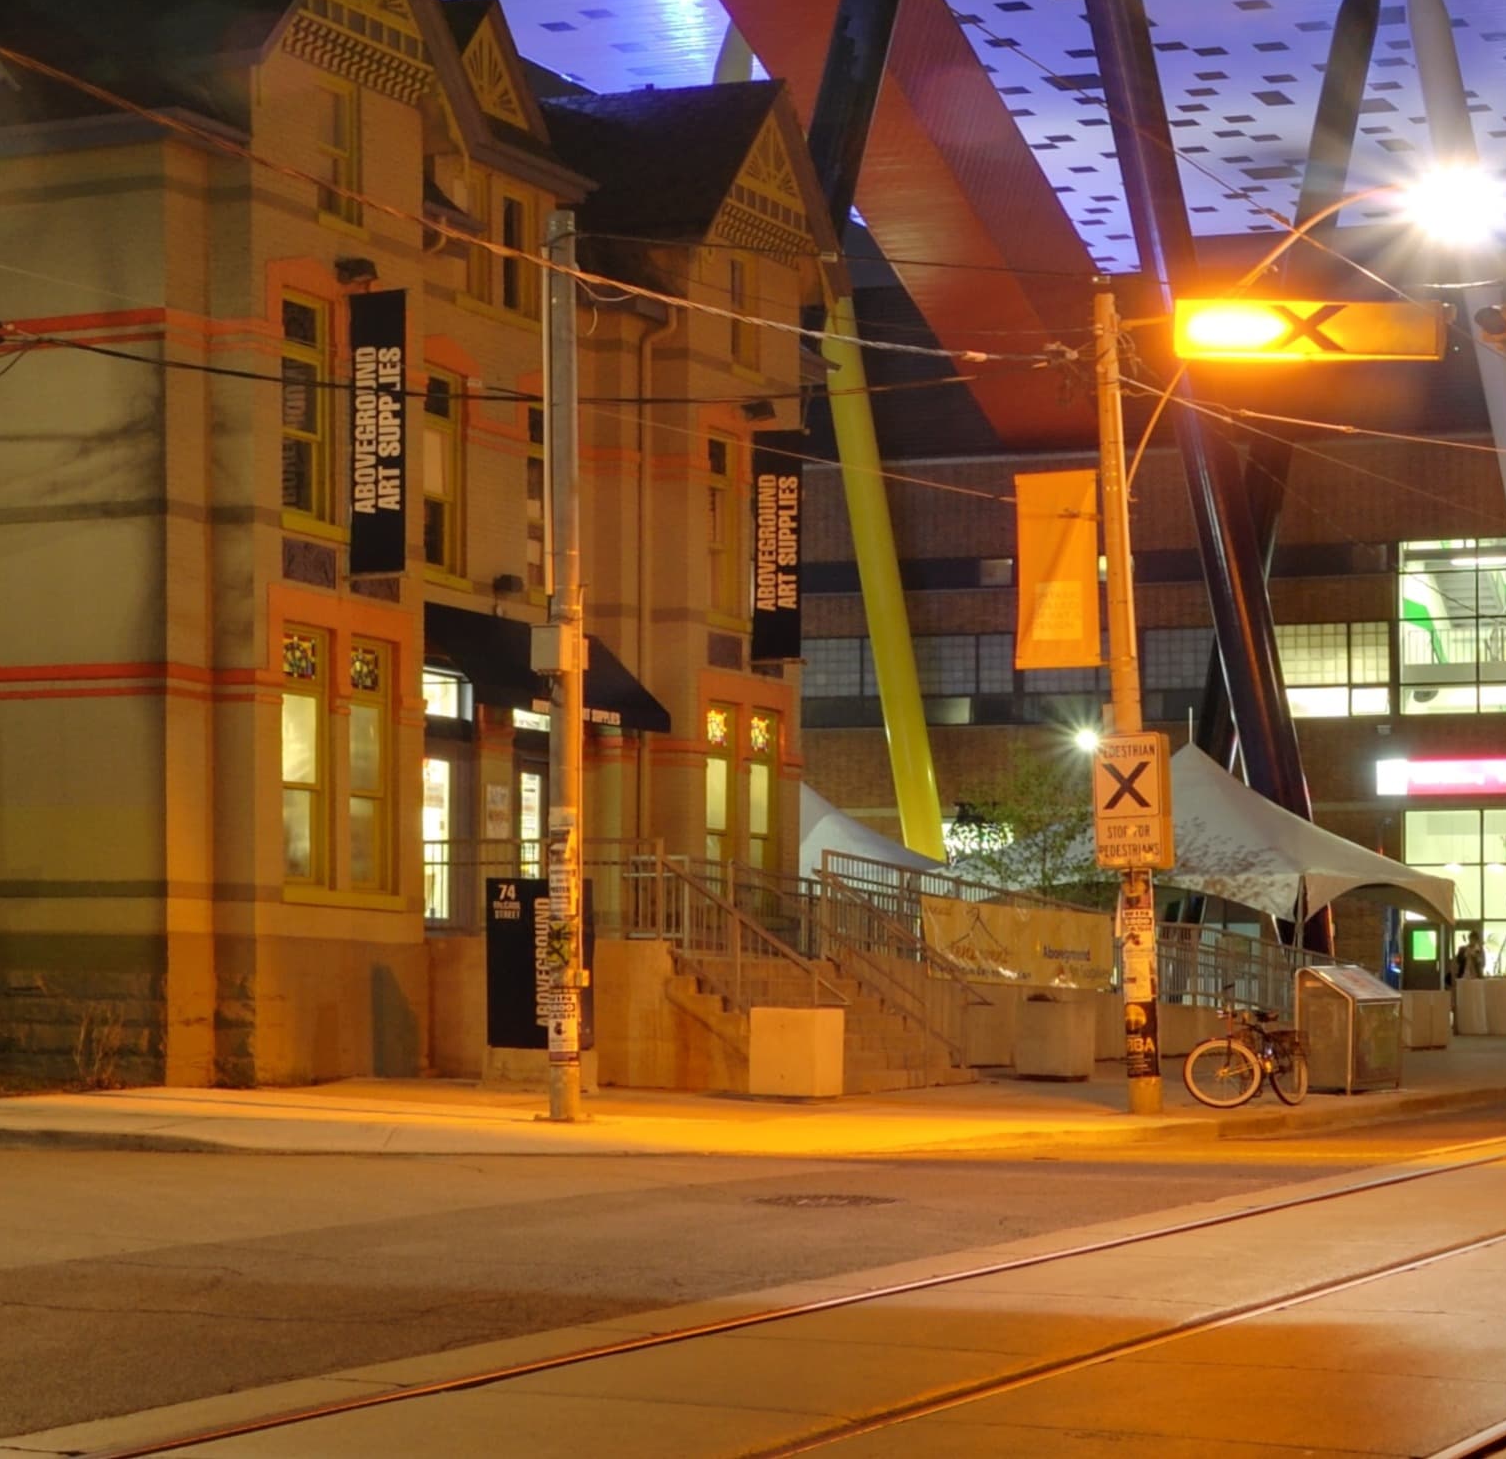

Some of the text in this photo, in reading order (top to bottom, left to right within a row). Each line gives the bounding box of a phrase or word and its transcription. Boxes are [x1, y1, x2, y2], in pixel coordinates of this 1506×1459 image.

[354, 346, 377, 515] ABOVEGROUND
[378, 346, 402, 511] ART SUPPLIES
[757, 474, 777, 612] ABOVEGROUND
[777, 475, 798, 610] ART SUPPLIES
[1100, 743, 1156, 759] PEDESTRIAN
[498, 884, 516, 902] 74
[1099, 843, 1161, 859] PEDESTRIANS
[535, 897, 552, 1027] ABOVEGROUND
